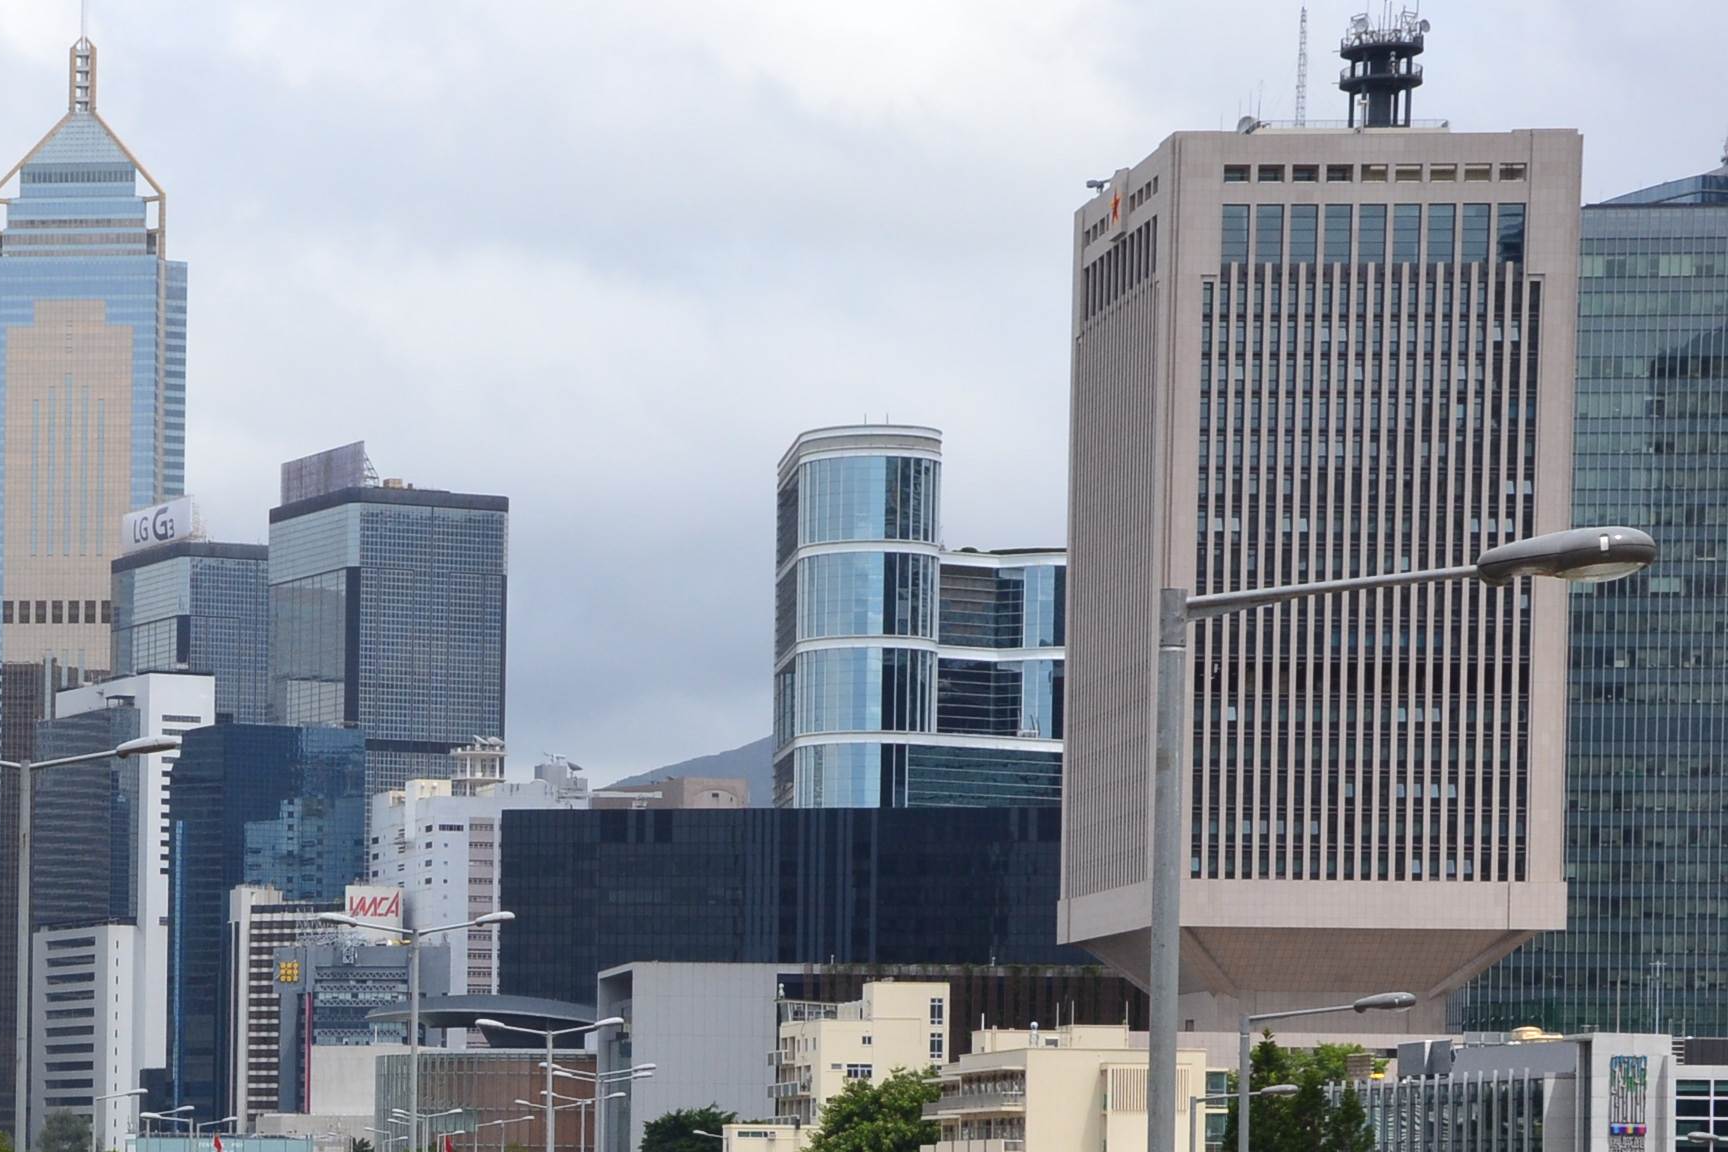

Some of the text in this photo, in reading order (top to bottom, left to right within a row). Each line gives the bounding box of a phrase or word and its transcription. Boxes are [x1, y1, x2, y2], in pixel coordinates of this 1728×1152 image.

[133, 507, 175, 543] LG G3
[349, 889, 400, 918] YMCA
